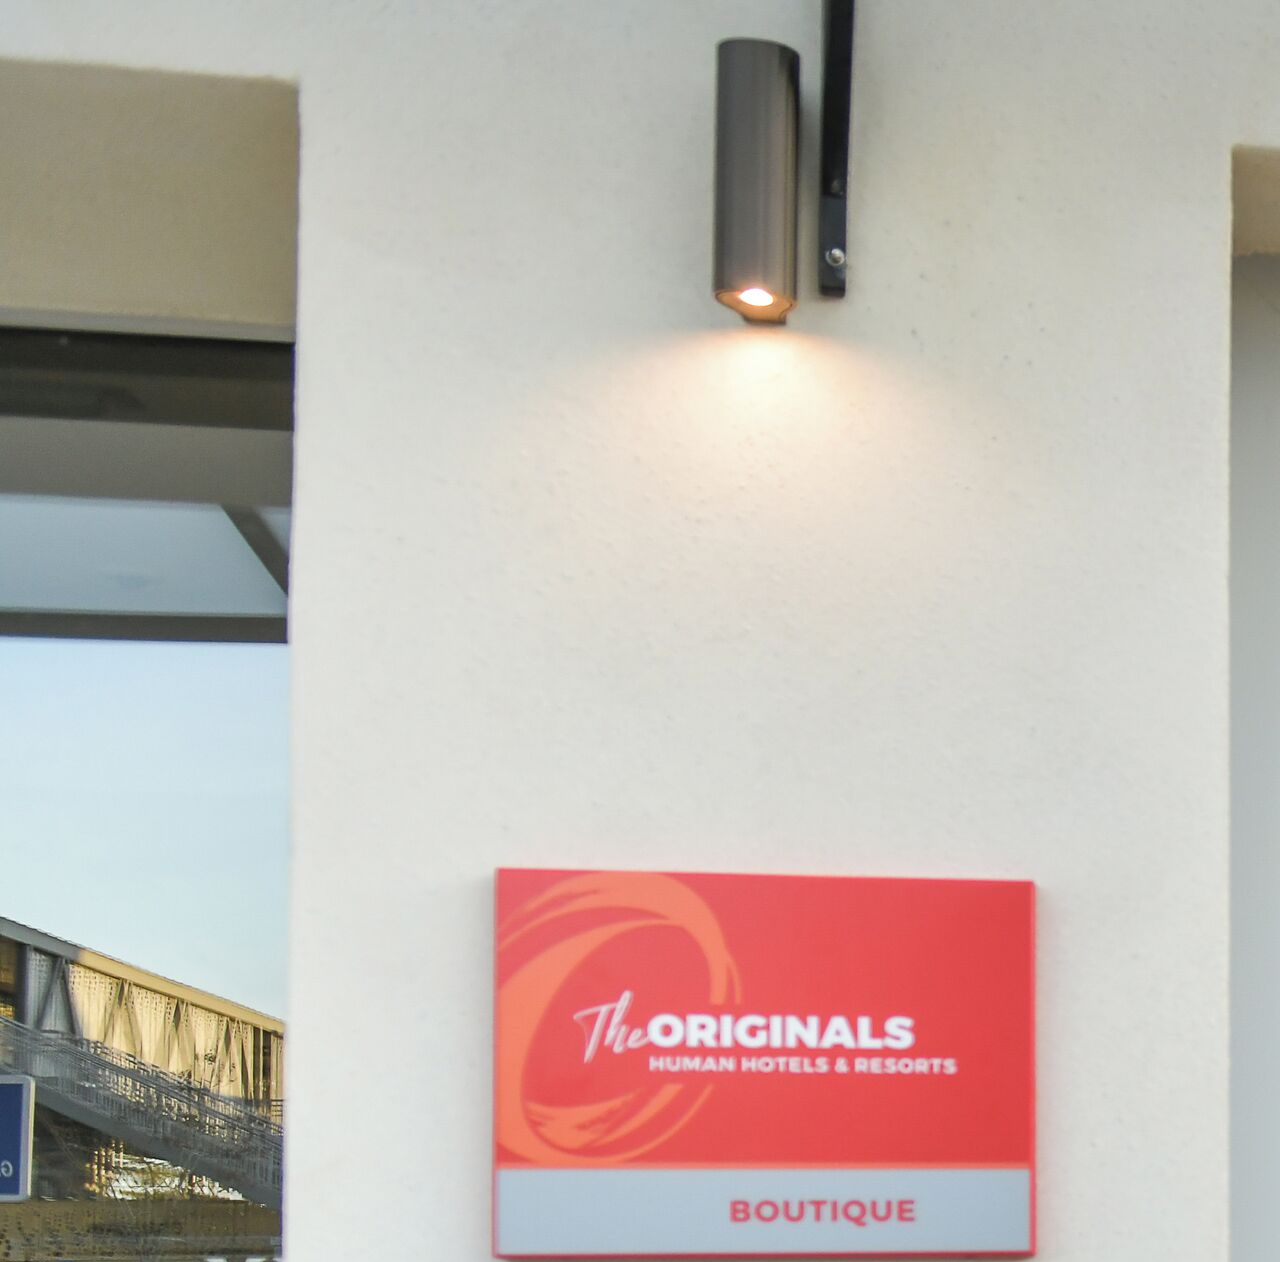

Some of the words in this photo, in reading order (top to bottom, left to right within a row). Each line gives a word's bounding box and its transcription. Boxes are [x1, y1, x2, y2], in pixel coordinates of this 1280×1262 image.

[573, 990, 649, 1065] The
[648, 1013, 915, 1049] ORIGINALS
[649, 1055, 736, 1073] HUMAN
[741, 1056, 830, 1074] HOTELS
[834, 1057, 850, 1074] &
[854, 1057, 958, 1075] RESORTS
[729, 1199, 917, 1227] BOUTIQUE
